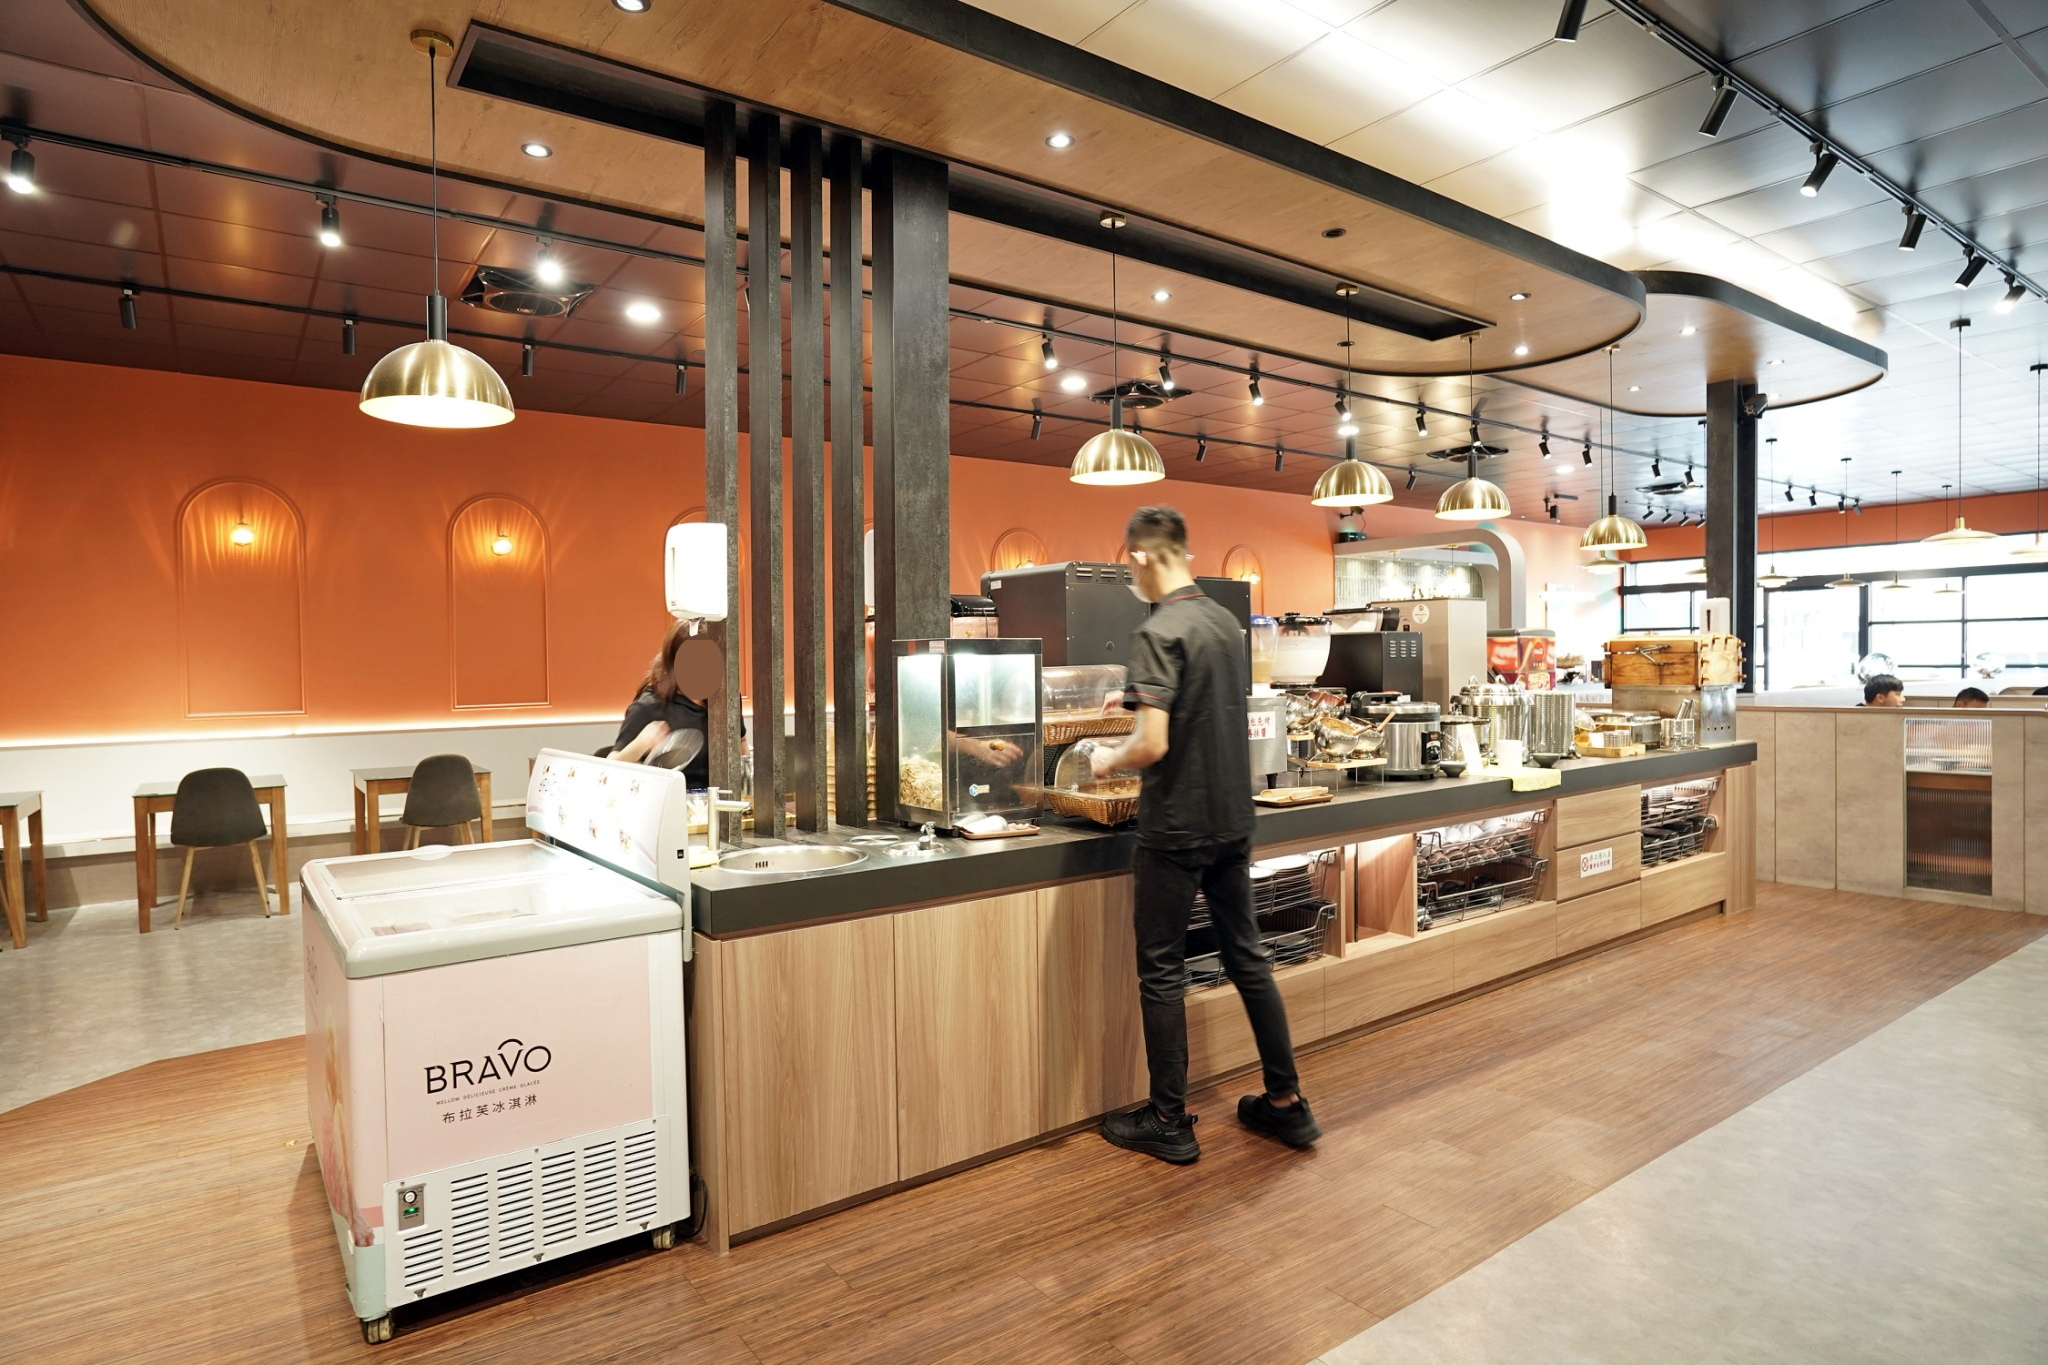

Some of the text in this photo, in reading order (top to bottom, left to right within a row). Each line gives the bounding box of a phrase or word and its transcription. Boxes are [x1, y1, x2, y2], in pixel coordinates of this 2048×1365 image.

[424, 1038, 552, 1095] BRAVO
[436, 1096, 461, 1105] MELLOW
[442, 1094, 537, 1124] 布拉芙冰淇淋
